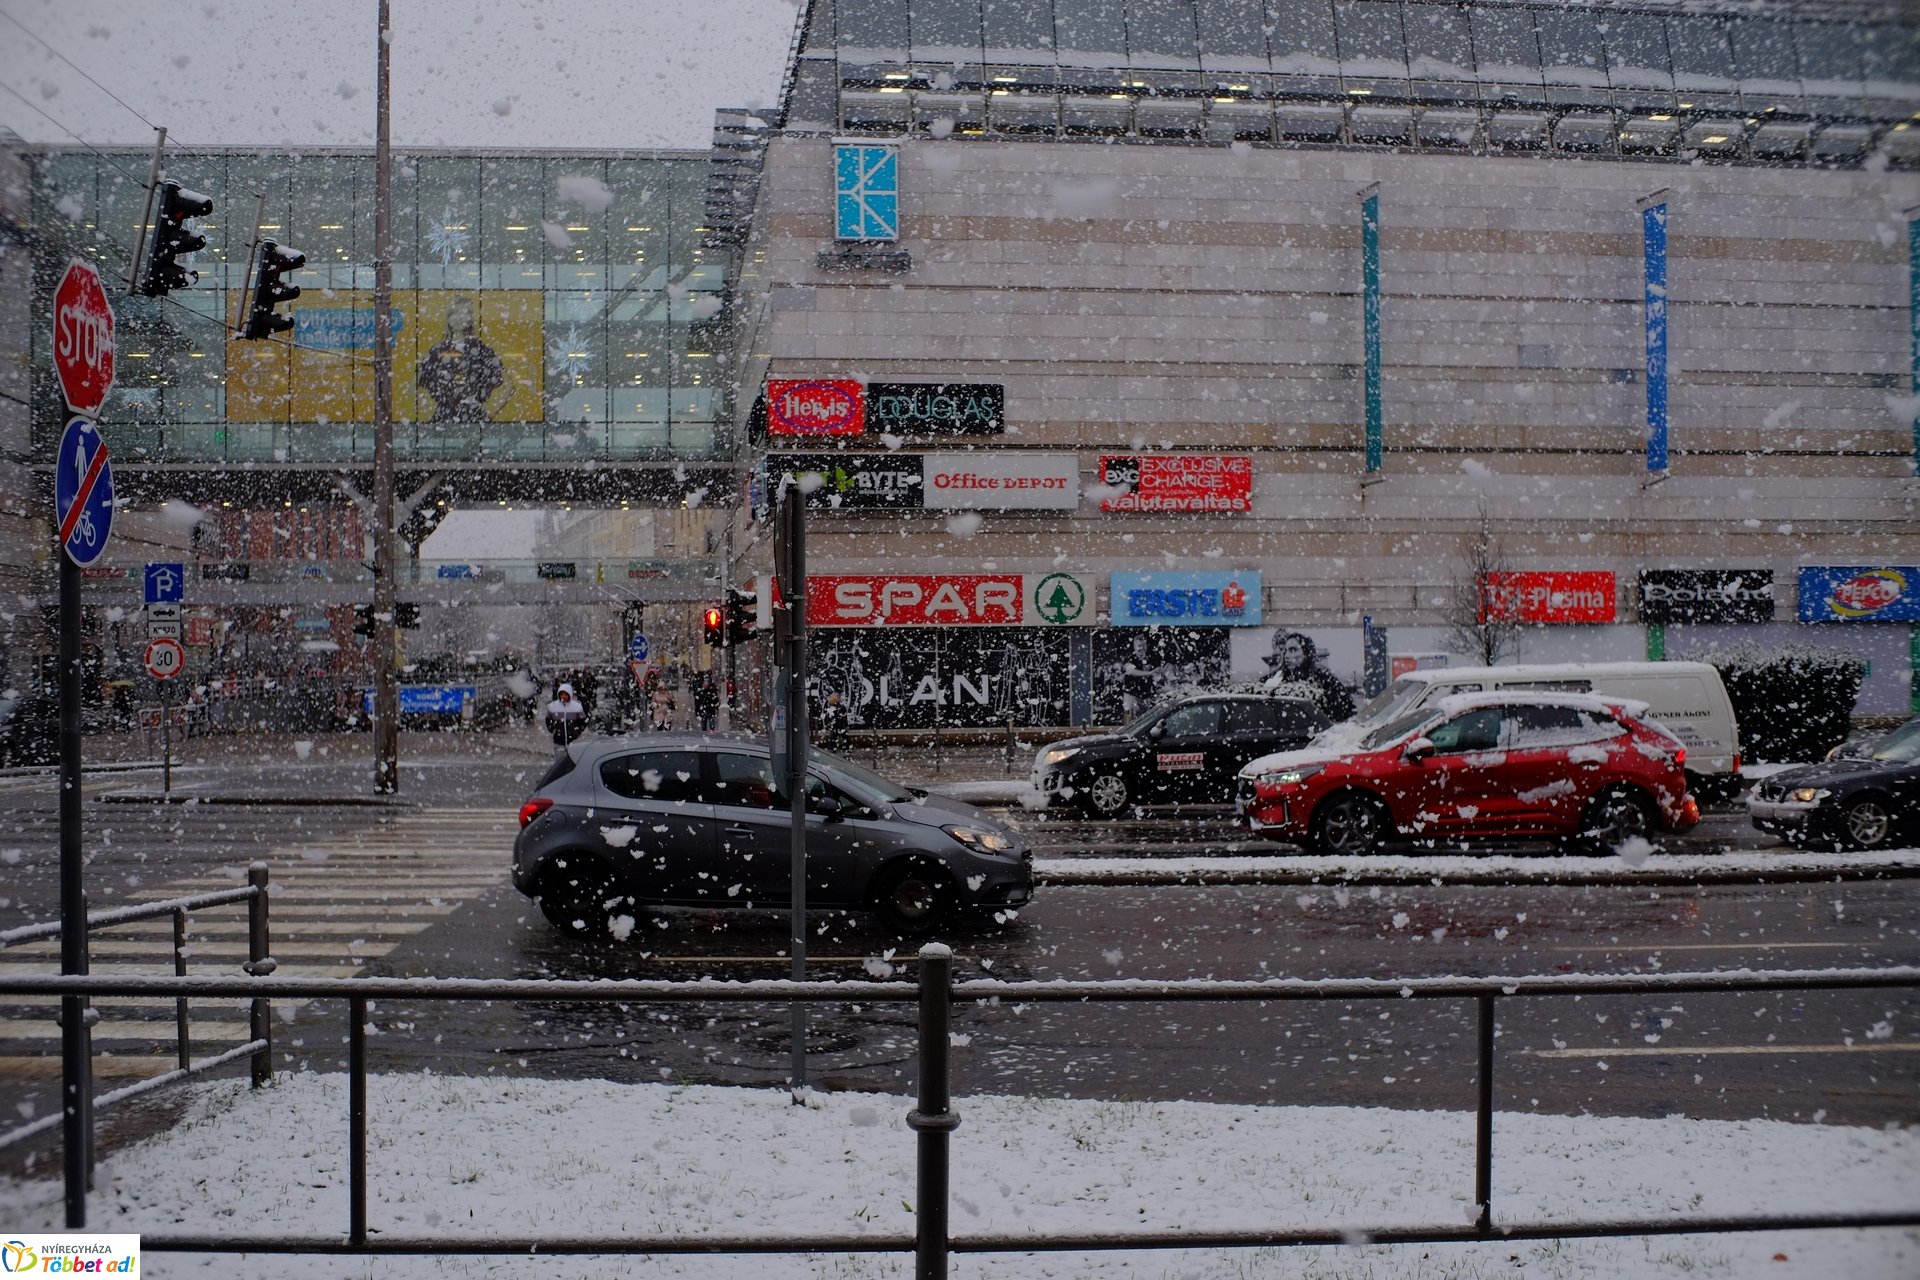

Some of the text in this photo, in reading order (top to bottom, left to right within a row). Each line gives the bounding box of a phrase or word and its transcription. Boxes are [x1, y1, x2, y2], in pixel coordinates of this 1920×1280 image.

[59, 305, 111, 371] STOP
[878, 395, 994, 420] DOUGLAS
[1142, 459, 1245, 473] EXCLUSIVE
[858, 471, 909, 488] BYTE
[934, 472, 1067, 490] Office DEPOT
[1142, 474, 1224, 488] CHANGE
[835, 582, 1018, 617] SPAR
[1533, 585, 1605, 609] Plsma
[1841, 581, 1893, 602] PEPCO
[1128, 588, 1219, 618] ERSTE
[156, 650, 173, 666] 30
